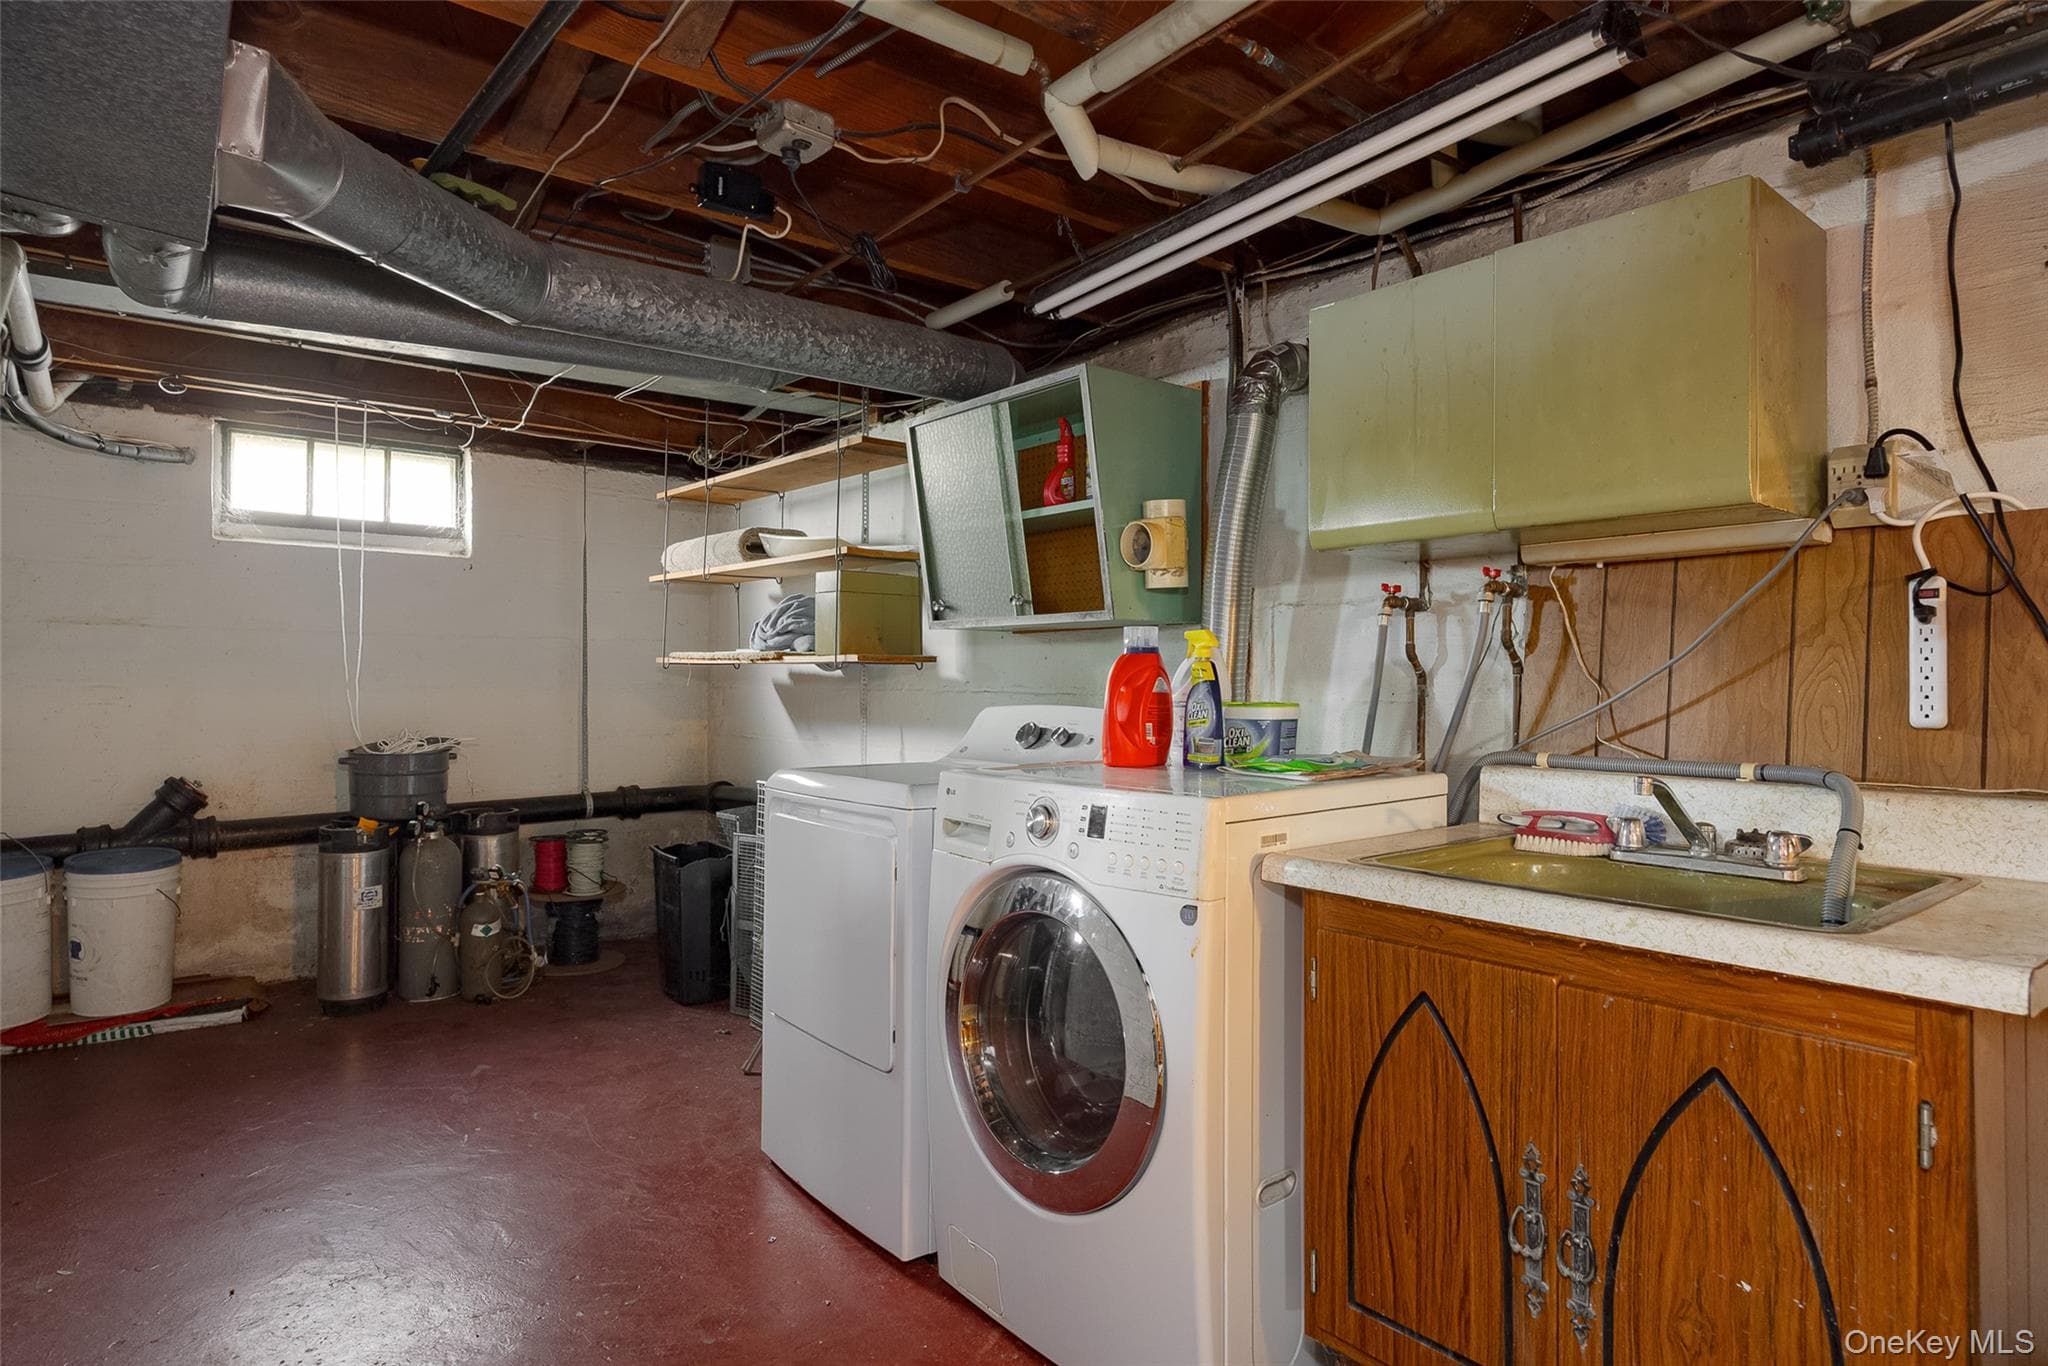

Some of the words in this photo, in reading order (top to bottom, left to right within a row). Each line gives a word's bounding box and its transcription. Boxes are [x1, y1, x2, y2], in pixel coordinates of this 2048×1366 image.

[1191, 702, 1204, 712] OXI
[1187, 709, 1208, 720] CLEAN
[1228, 727, 1244, 738] OXI
[1224, 736, 1251, 747] CLEAN
